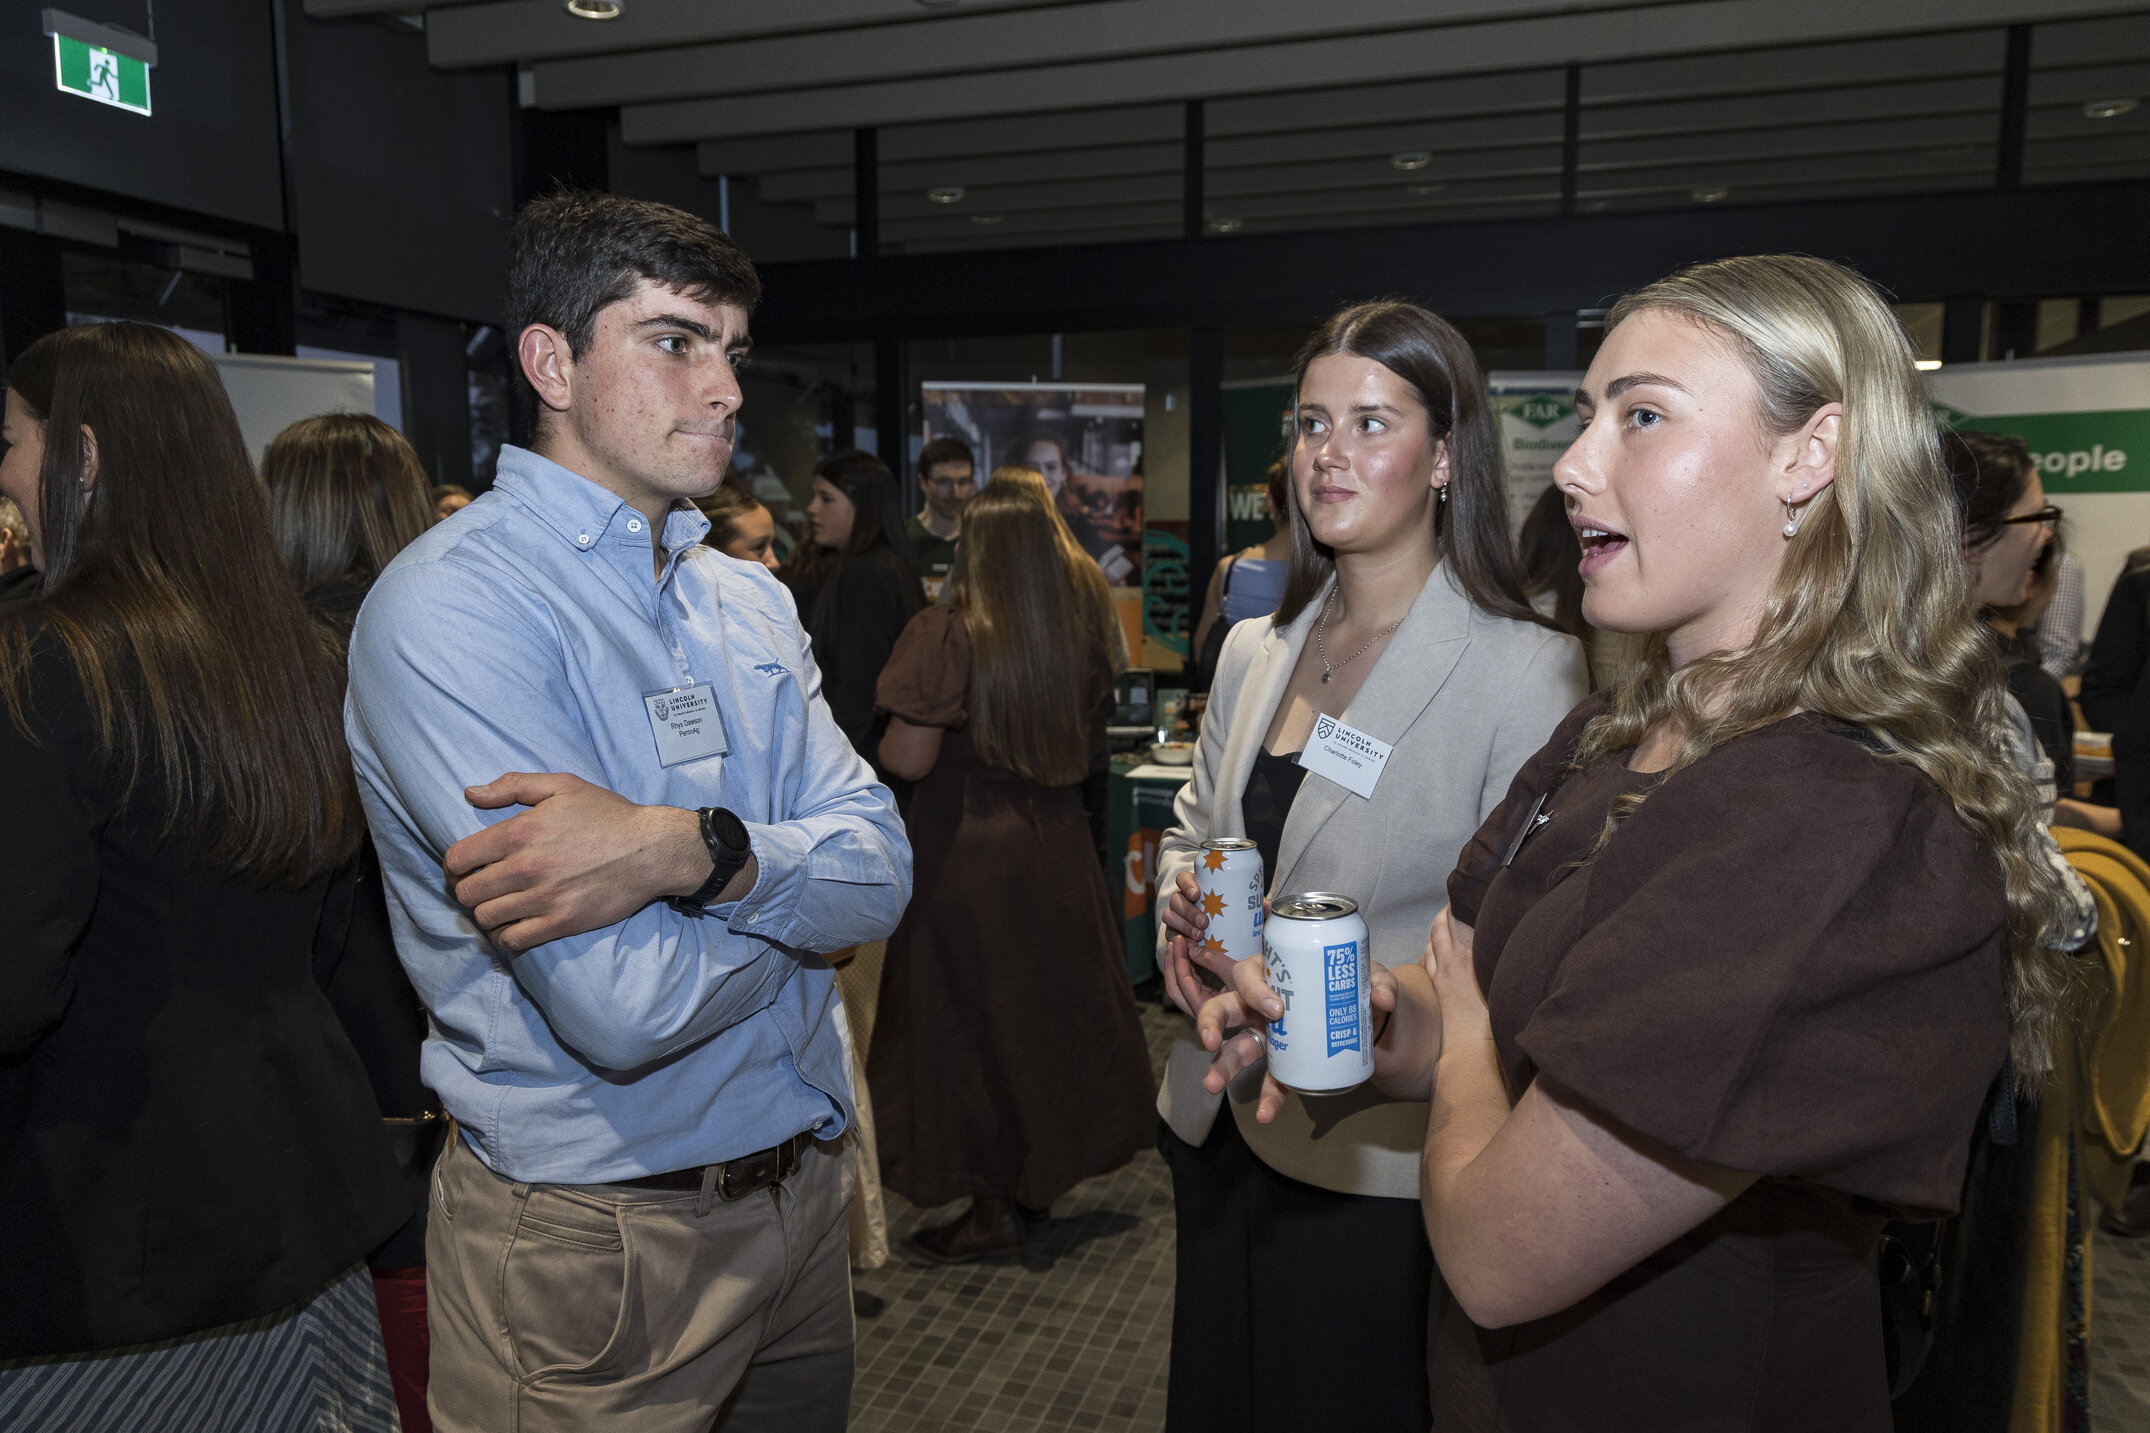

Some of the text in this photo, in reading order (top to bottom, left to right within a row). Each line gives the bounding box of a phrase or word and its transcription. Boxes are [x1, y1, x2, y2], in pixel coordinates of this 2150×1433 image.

[1523, 403, 1560, 418] FAR
[669, 694, 695, 705] LINCOLN
[671, 698, 708, 711] UNIVERSITY
[670, 717, 703, 730] Rhys Dawson
[1338, 727, 1372, 746] LINCOLN
[1335, 733, 1384, 760] UNIVERSITY
[1323, 745, 1348, 761] Charlotte
[1347, 756, 1363, 769] Foley
[1327, 946, 1355, 966] 75%
[1328, 962, 1356, 981] LESS
[1328, 977, 1356, 992] CARBS
[1329, 1004, 1357, 1018] ONLY 88
[1329, 1013, 1358, 1026] CALORIES
[1330, 1027, 1358, 1041] CRISP &
